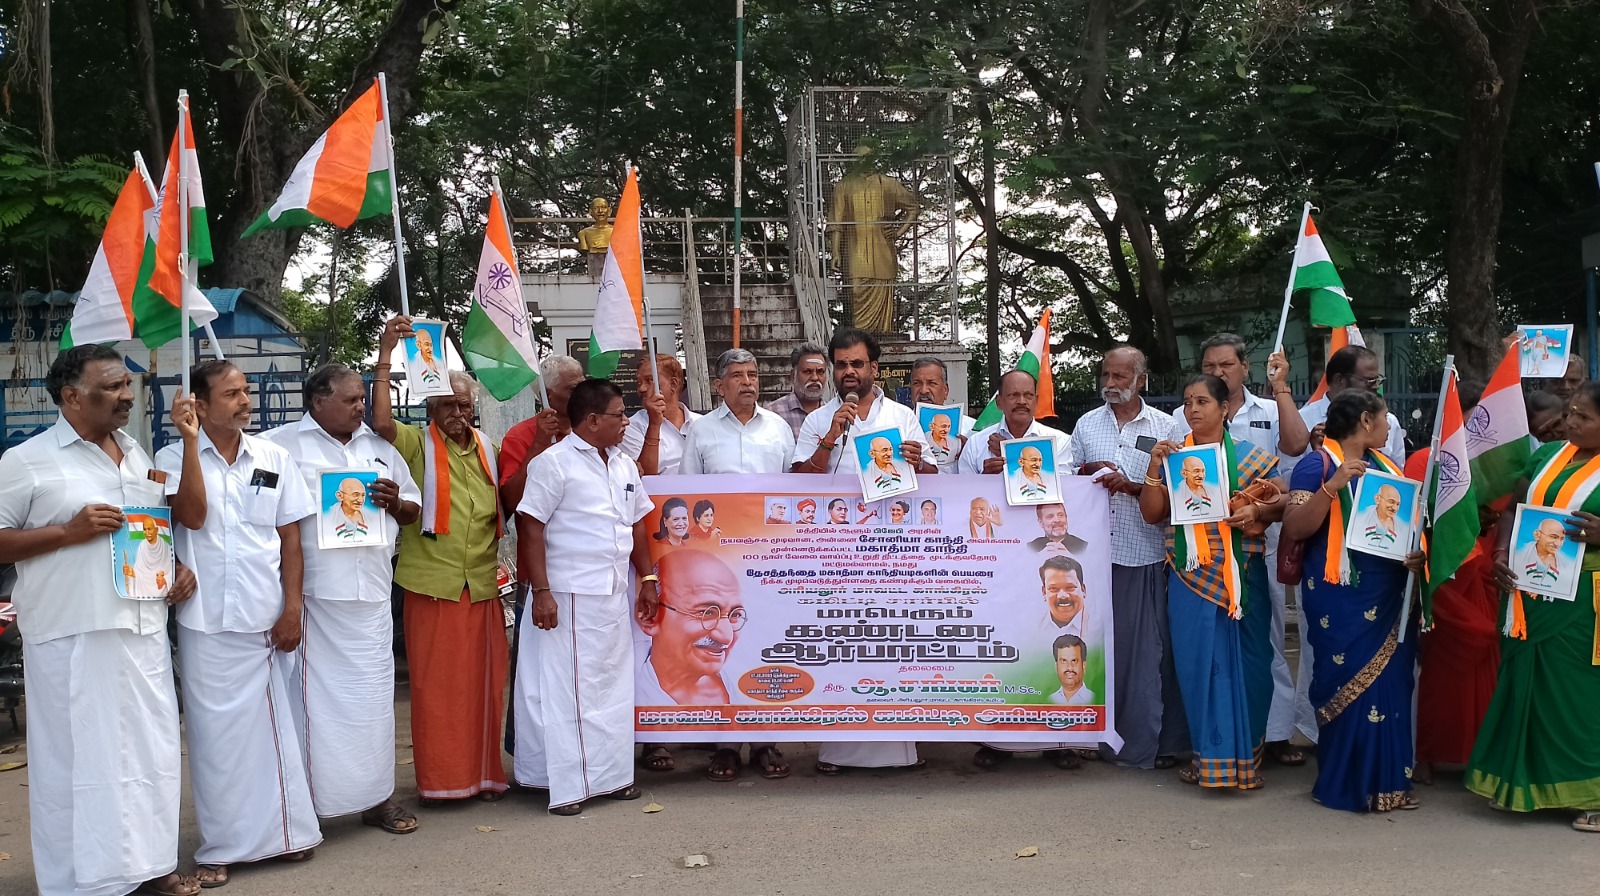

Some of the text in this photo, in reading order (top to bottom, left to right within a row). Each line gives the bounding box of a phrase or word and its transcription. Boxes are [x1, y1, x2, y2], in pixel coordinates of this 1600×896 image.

[859, 534, 921, 544] சோனியா
[924, 535, 964, 545] காந்தி
[855, 544, 920, 555] மகாத்மா
[923, 544, 968, 555] காந்தி
[746, 568, 994, 578] தேசத்தந்தை மகாத்மா காந்தியடிகளின் பெயரை
[816, 606, 973, 620] மாபெரும்
[784, 619, 995, 642] கண்டன
[761, 640, 1019, 666] ஆர்பாட்டம்
[898, 665, 955, 673] தலைமை
[823, 673, 1042, 696] திரு. ஆ.சங்கர் M.Sc.,
[639, 706, 1097, 729] மாவட்ட காங்கிரஸ் கமிட்டி, அரியலூர்
